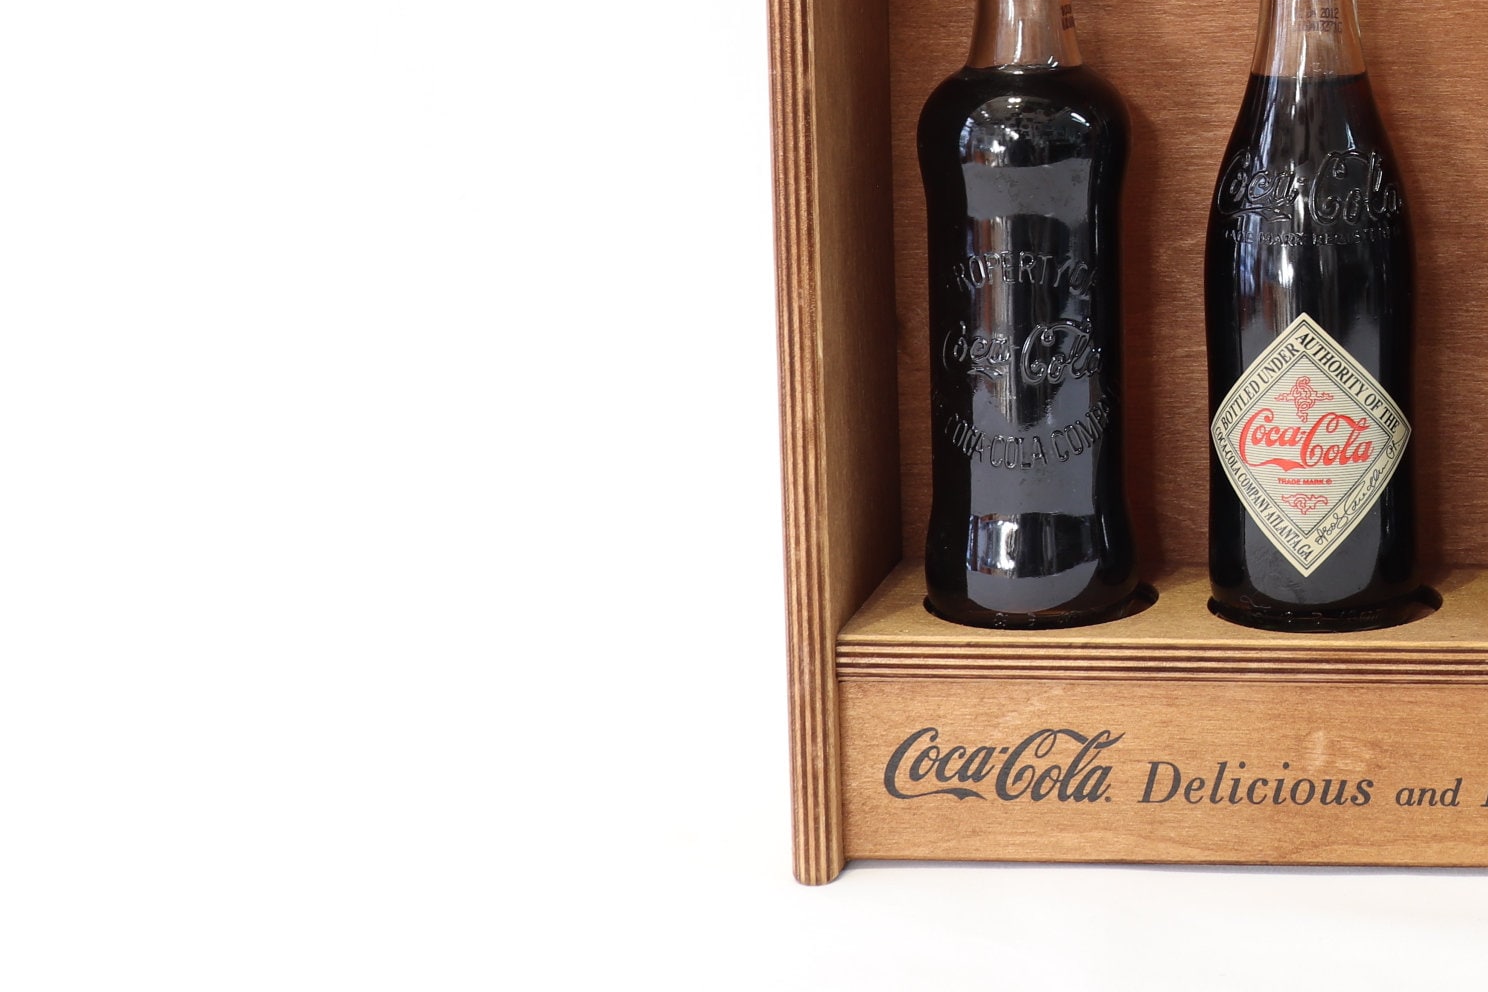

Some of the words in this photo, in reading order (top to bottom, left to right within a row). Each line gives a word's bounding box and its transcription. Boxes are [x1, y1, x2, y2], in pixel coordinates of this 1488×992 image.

[1220, 377, 1261, 431] BOTTLED
[1259, 342, 1300, 385] UNDER
[1295, 333, 1369, 400] AUTHORITY
[1366, 393, 1385, 416] OF
[1378, 405, 1400, 434] THE
[1214, 427, 1246, 481] COCA-COLA
[1237, 467, 1272, 513] COMPANY
[1239, 408, 1374, 472] Coca-Cola
[884, 727, 1125, 803] Coca-Cola
[1138, 761, 1374, 806] Delicious
[1395, 777, 1463, 808] and
